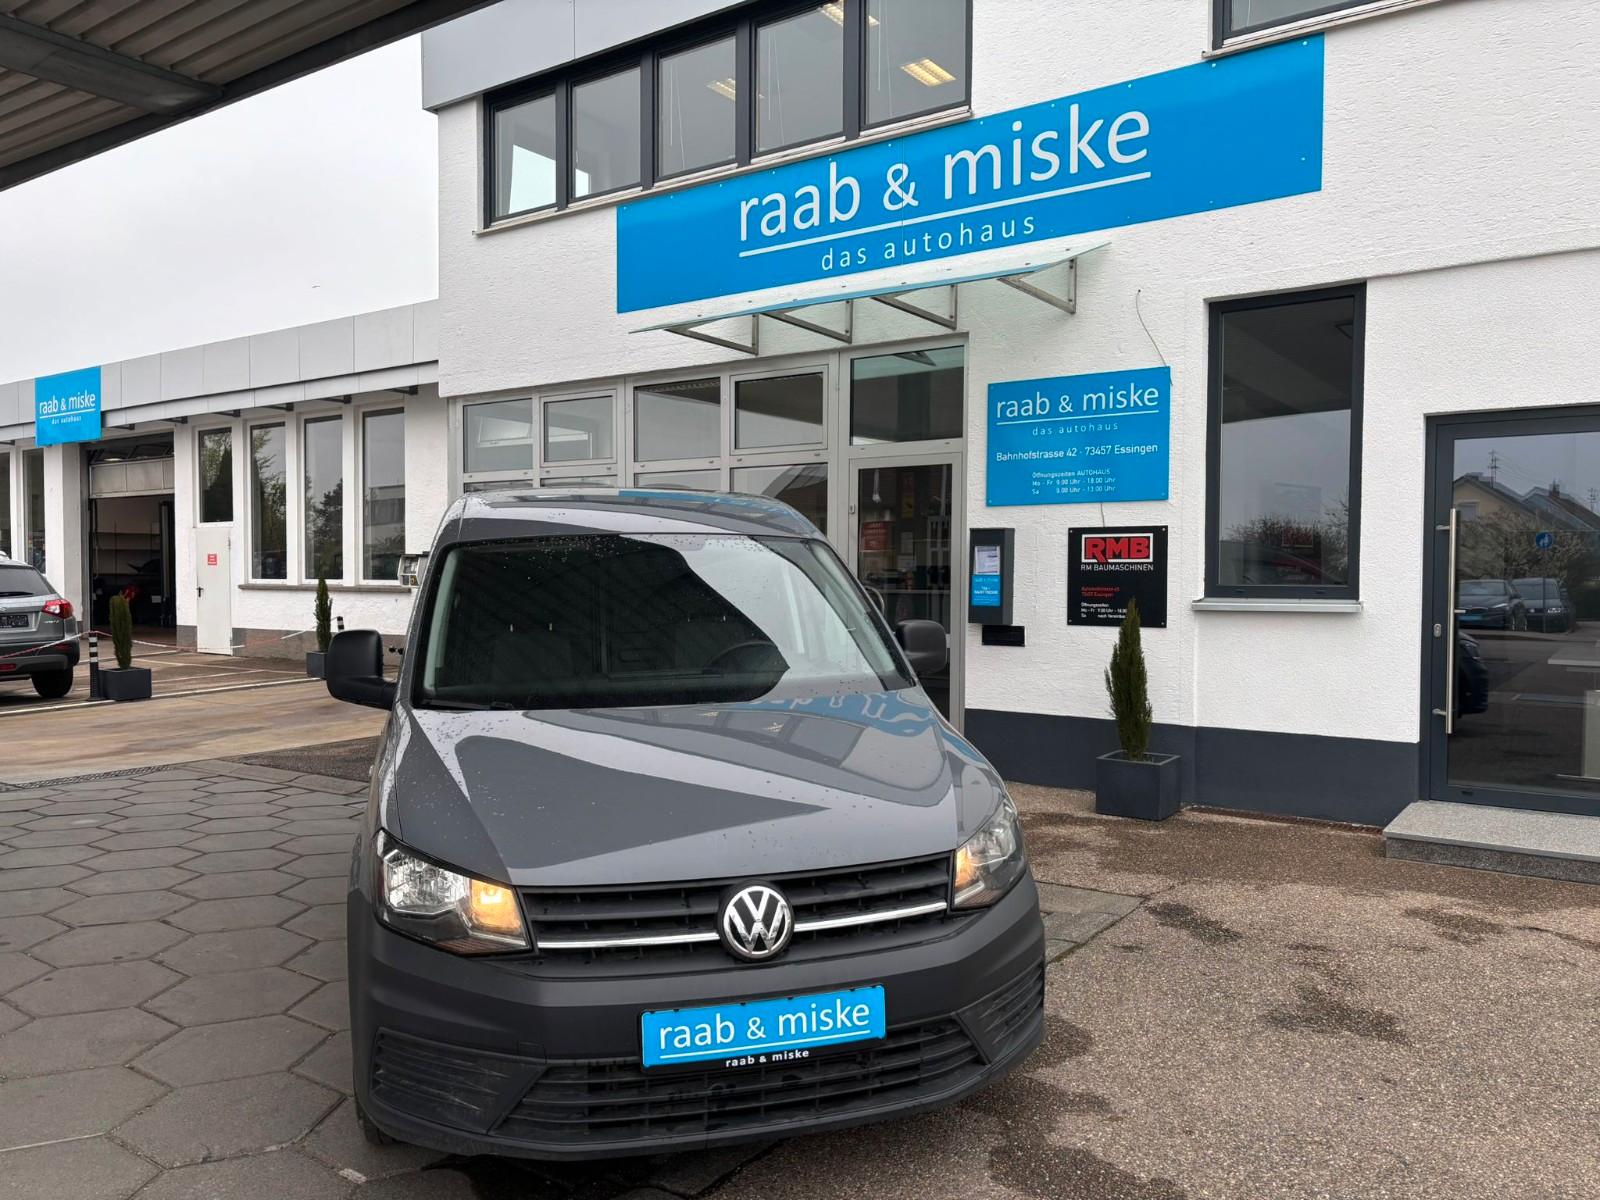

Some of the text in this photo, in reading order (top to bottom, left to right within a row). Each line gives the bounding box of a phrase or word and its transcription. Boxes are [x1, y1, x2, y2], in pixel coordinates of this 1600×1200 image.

[739, 103, 1151, 242] raab & miske
[820, 215, 1036, 271] das autohaus
[39, 389, 96, 415] raab & miske
[996, 382, 1160, 419] raab & miske
[1032, 422, 1119, 437] das autohaus
[996, 449, 1065, 462] Bahnhofstrasse
[1066, 447, 1078, 458] 42
[1084, 445, 1112, 456] 73457
[1114, 443, 1159, 456] Essingen
[1076, 469, 1111, 477] AUTOHAUS
[1104, 484, 1116, 492] Uhr
[1084, 537, 1150, 564] RMB
[1093, 563, 1154, 571] BAUMASCHINEN
[659, 998, 870, 1050] raab & miske
[725, 1049, 810, 1068] raab & miske
